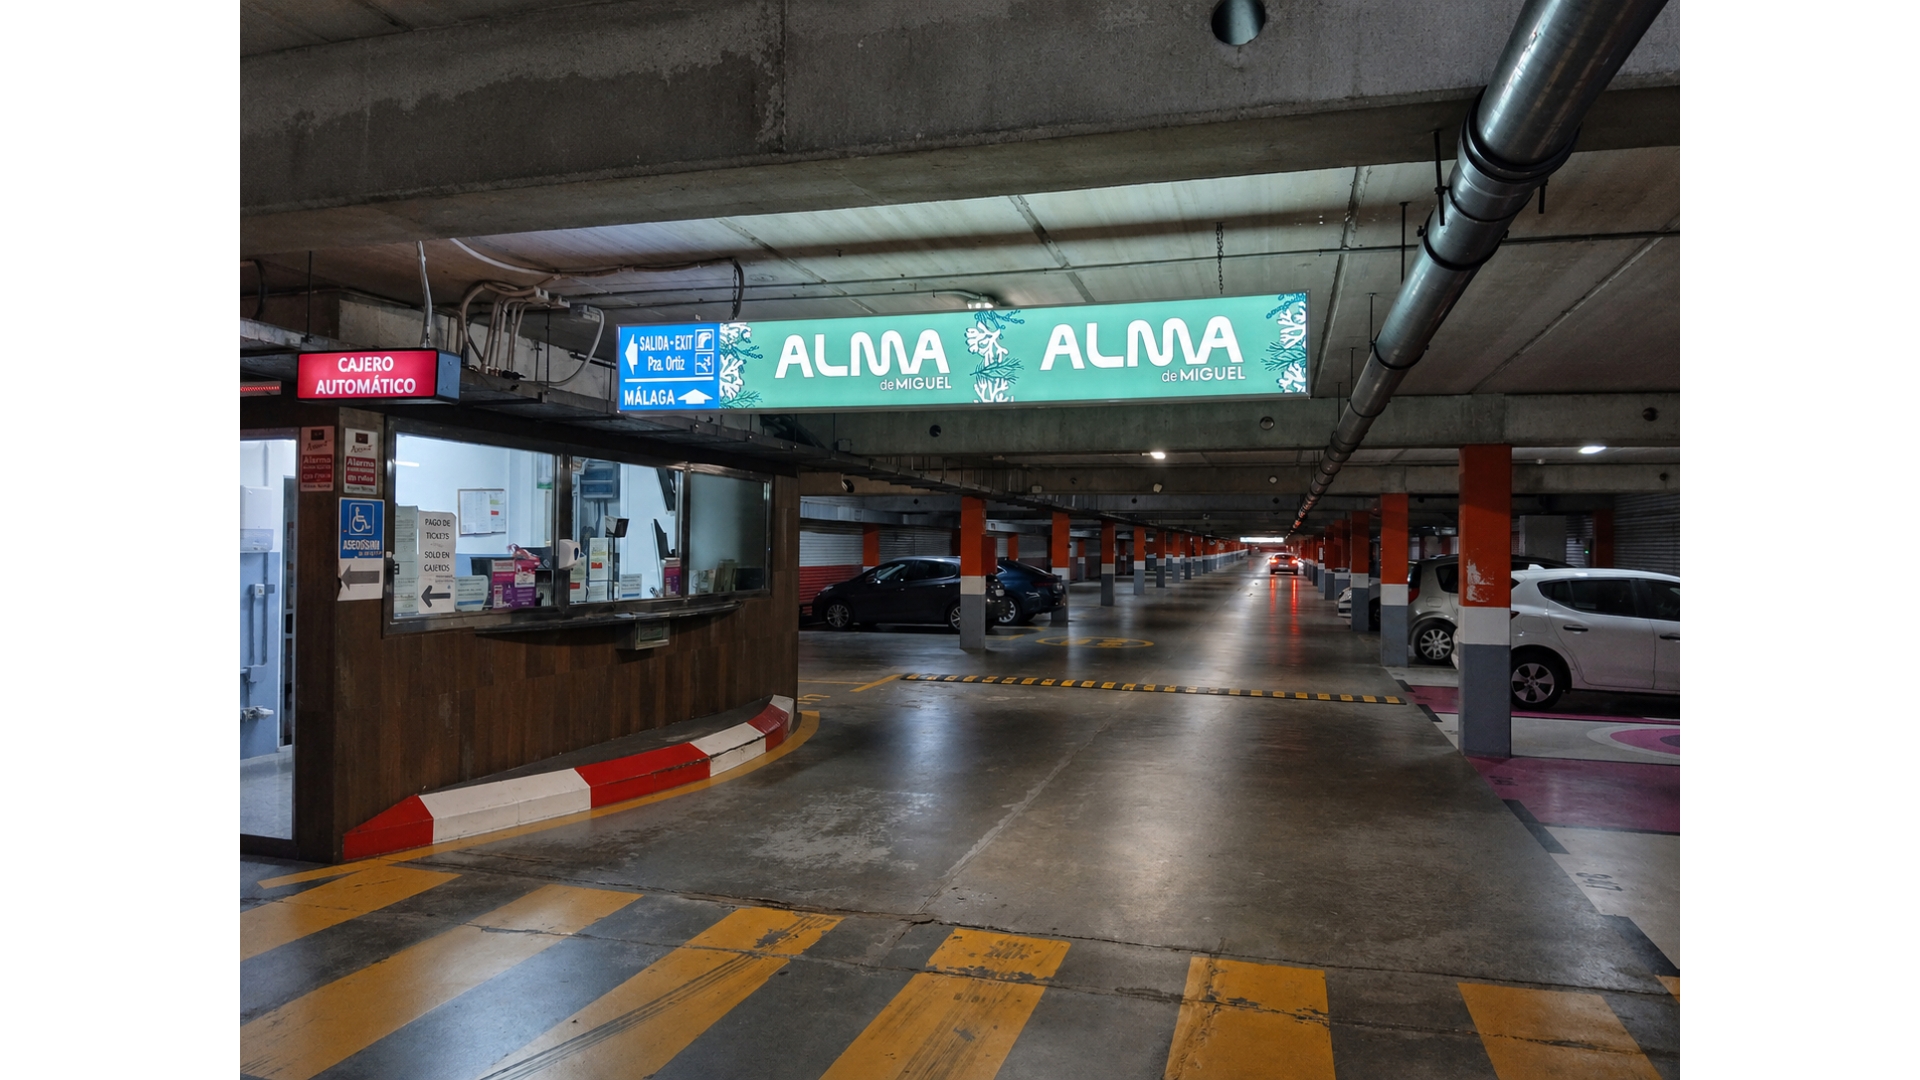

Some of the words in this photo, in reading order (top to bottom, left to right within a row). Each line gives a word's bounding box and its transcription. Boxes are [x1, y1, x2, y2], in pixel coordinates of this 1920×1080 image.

[1040, 316, 1244, 371] ALMA
[775, 329, 950, 379] ALMA
[338, 356, 394, 373] CAJERO
[648, 356, 664, 371] Pza.
[665, 355, 685, 371] Ortiz
[1179, 366, 1246, 382] MIGUEL
[315, 375, 416, 395] AUTOMÁTICO
[895, 376, 952, 390] MIGUEL
[624, 385, 675, 406] MÁLAGA
[425, 518, 441, 527] PAGO
[442, 519, 451, 527] DE
[424, 551, 441, 559] SOLO
[442, 551, 450, 559] EN
